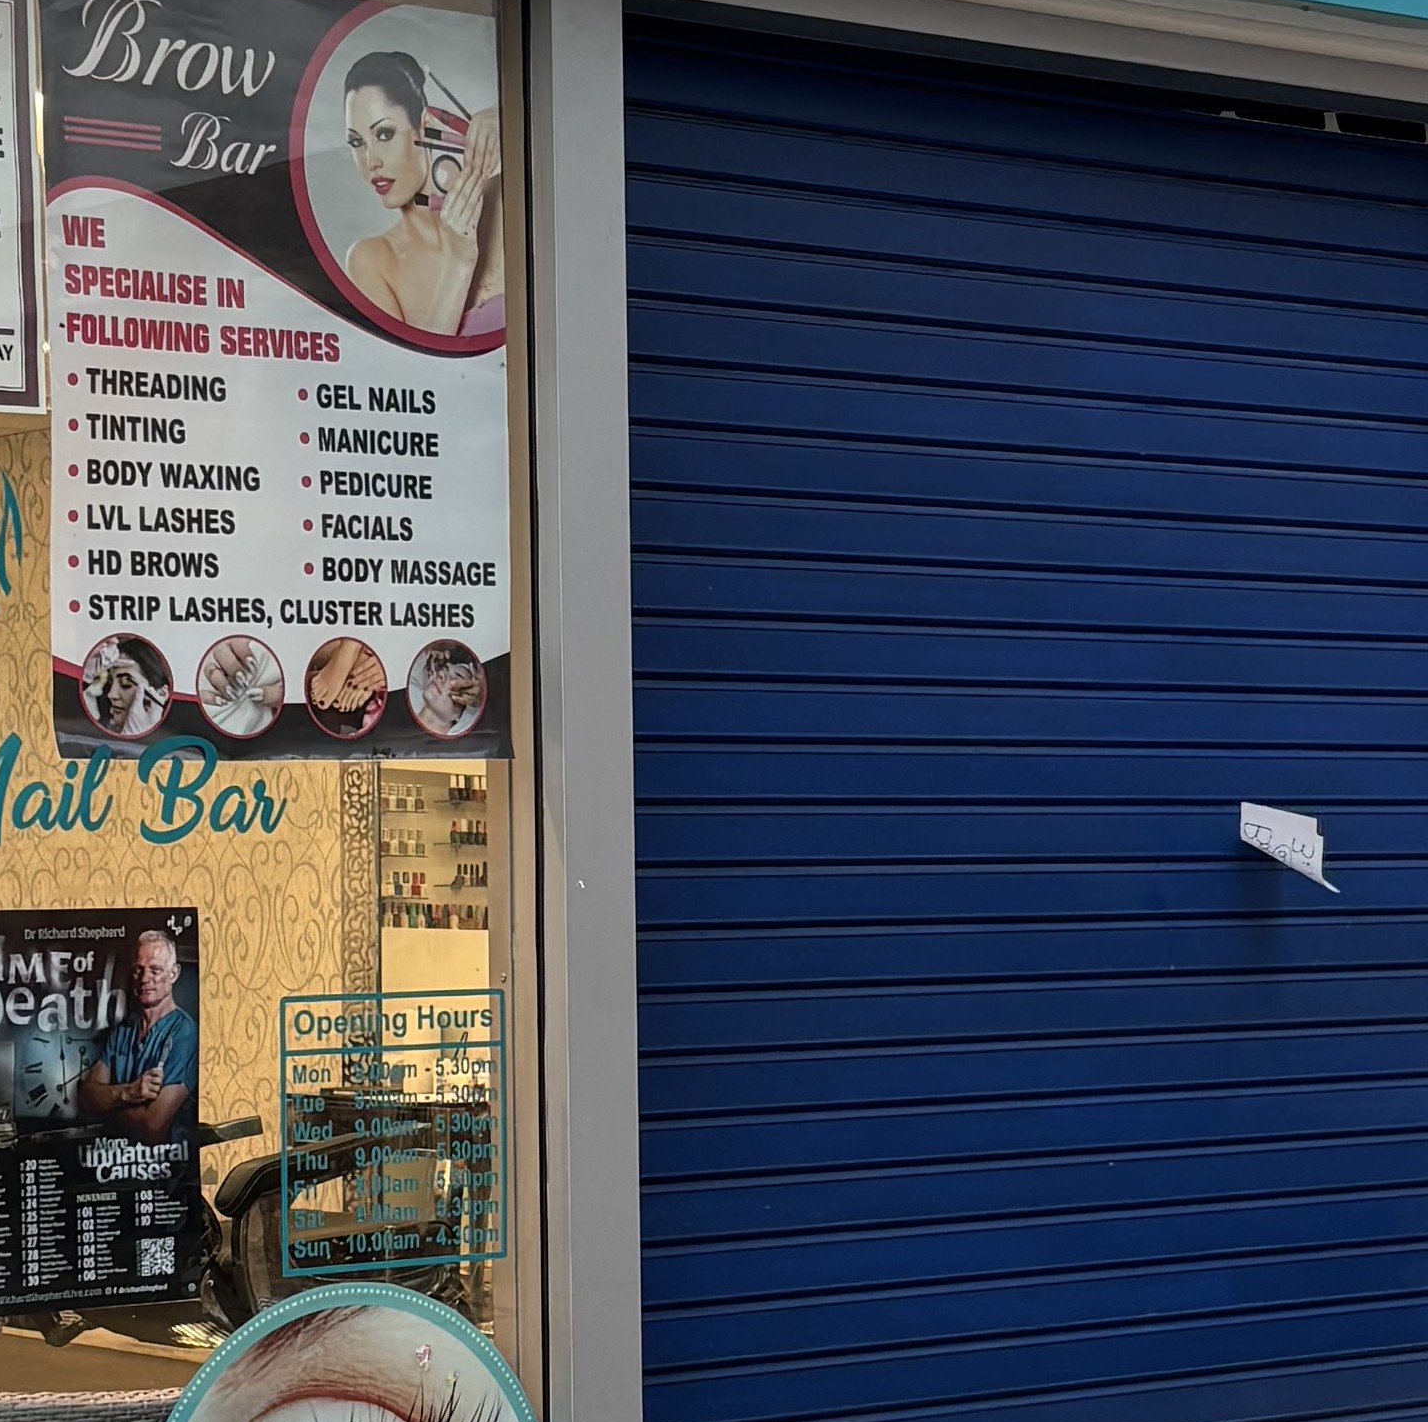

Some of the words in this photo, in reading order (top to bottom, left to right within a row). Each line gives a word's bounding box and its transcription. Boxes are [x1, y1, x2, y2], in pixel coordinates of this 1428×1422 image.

[170, 112, 275, 176] Bar
[63, 217, 106, 248] WE
[65, 264, 210, 307] SPECIALISE
[217, 278, 245, 309] IN
[67, 313, 210, 353] FOLLOWING
[221, 328, 340, 362] SERVICES
[87, 369, 227, 402] THREADING
[316, 384, 362, 411] GEL
[368, 387, 436, 415] NAILS
[86, 415, 187, 446] TINTING
[318, 427, 440, 458] MANICURE
[87, 461, 154, 490] BODY
[160, 463, 261, 492] WAXING
[320, 471, 433, 501] PEDICURE
[87, 505, 133, 533] LVL
[139, 508, 235, 536] LASHES
[321, 514, 413, 543] FACIALS
[88, 551, 124, 577] HD
[130, 552, 219, 579] BROWS
[322, 558, 383, 586] BODY
[390, 560, 497, 587] MASSAGE
[88, 596, 161, 622] STRIP
[169, 598, 273, 629] LASHES,
[281, 600, 384, 627] CLUSTER
[390, 601, 475, 629] LASHES
[137, 735, 288, 844] Bar
[24, 929, 36, 940] Dr
[38, 927, 76, 939] Richard
[73, 951, 94, 973] of
[293, 1009, 407, 1041] Opening
[417, 1005, 493, 1030] Hours
[292, 1064, 331, 1084] Mon
[435, 1057, 496, 1078] 5.30pm
[292, 1094, 325, 1113] Tue
[435, 1083, 497, 1105] 5.30pm
[292, 1121, 332, 1141] Wed
[435, 1113, 497, 1134] 5.30pm
[79, 1140, 188, 1168] Unnatural
[95, 1137, 128, 1150] More
[293, 1150, 328, 1171] Thu
[435, 1140, 497, 1160] 5.30pm
[96, 1163, 172, 1183] Causes
[293, 1179, 317, 1199] Fri
[294, 1209, 324, 1227] Sat
[293, 1239, 331, 1260] Sun
[346, 1233, 420, 1254] 10.00am
[436, 1227, 498, 1247] 4.30pm
